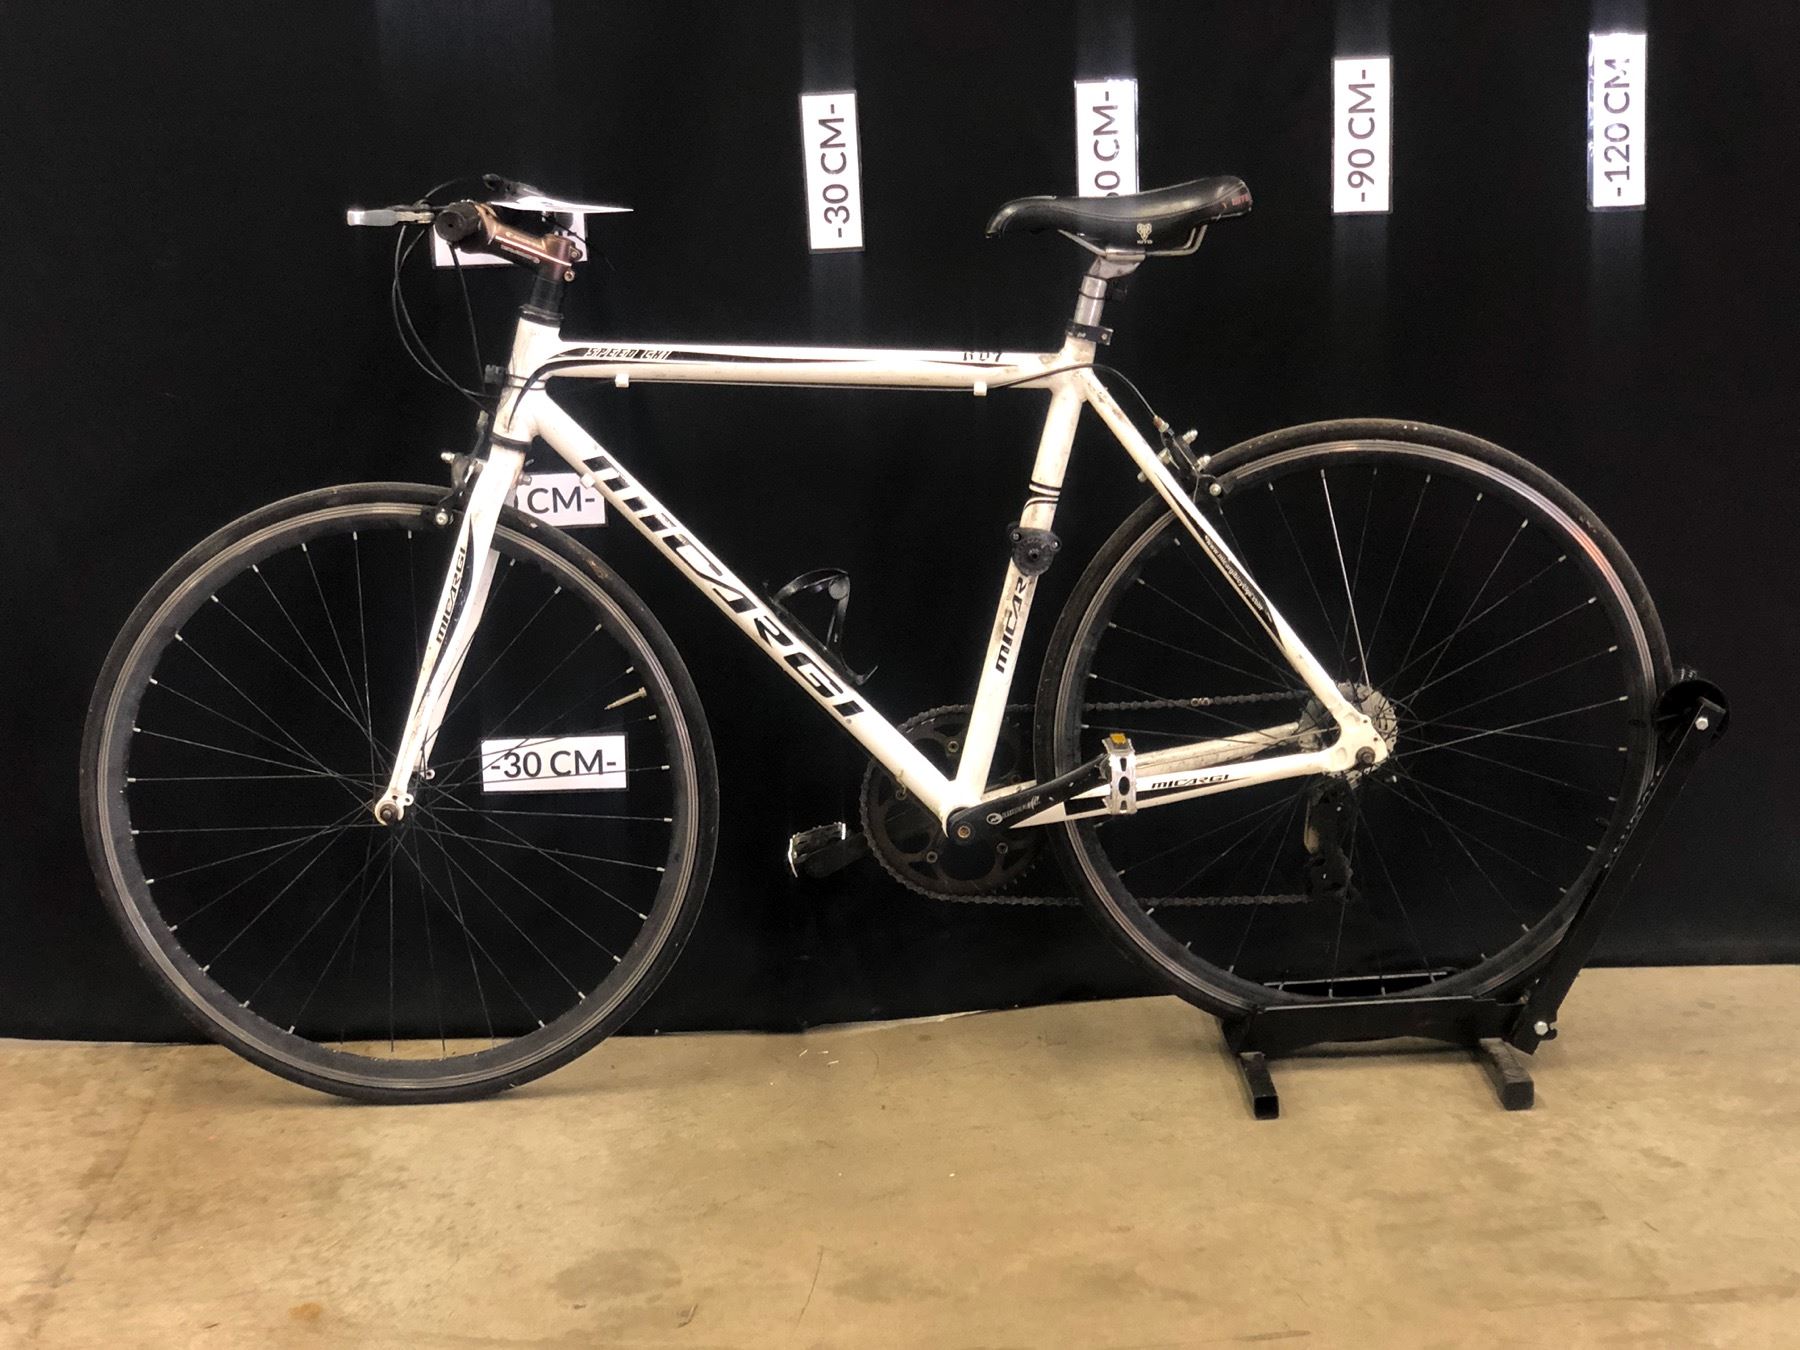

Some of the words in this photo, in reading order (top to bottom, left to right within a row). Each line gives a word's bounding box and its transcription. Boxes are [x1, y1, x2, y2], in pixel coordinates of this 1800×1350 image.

[1092, 91, 1120, 162] CM-
[1348, 69, 1376, 140] CM-
[818, 103, 848, 176] CM-
[1604, 122, 1631, 198] -120
[1094, 170, 1121, 198] 0
[1348, 149, 1376, 203] -90
[823, 183, 851, 239] -30
[584, 347, 641, 360] SPEED
[527, 485, 596, 514] CM-
[995, 576, 1028, 675] MICAR
[491, 752, 541, 778] -30
[550, 750, 617, 776] CM-
